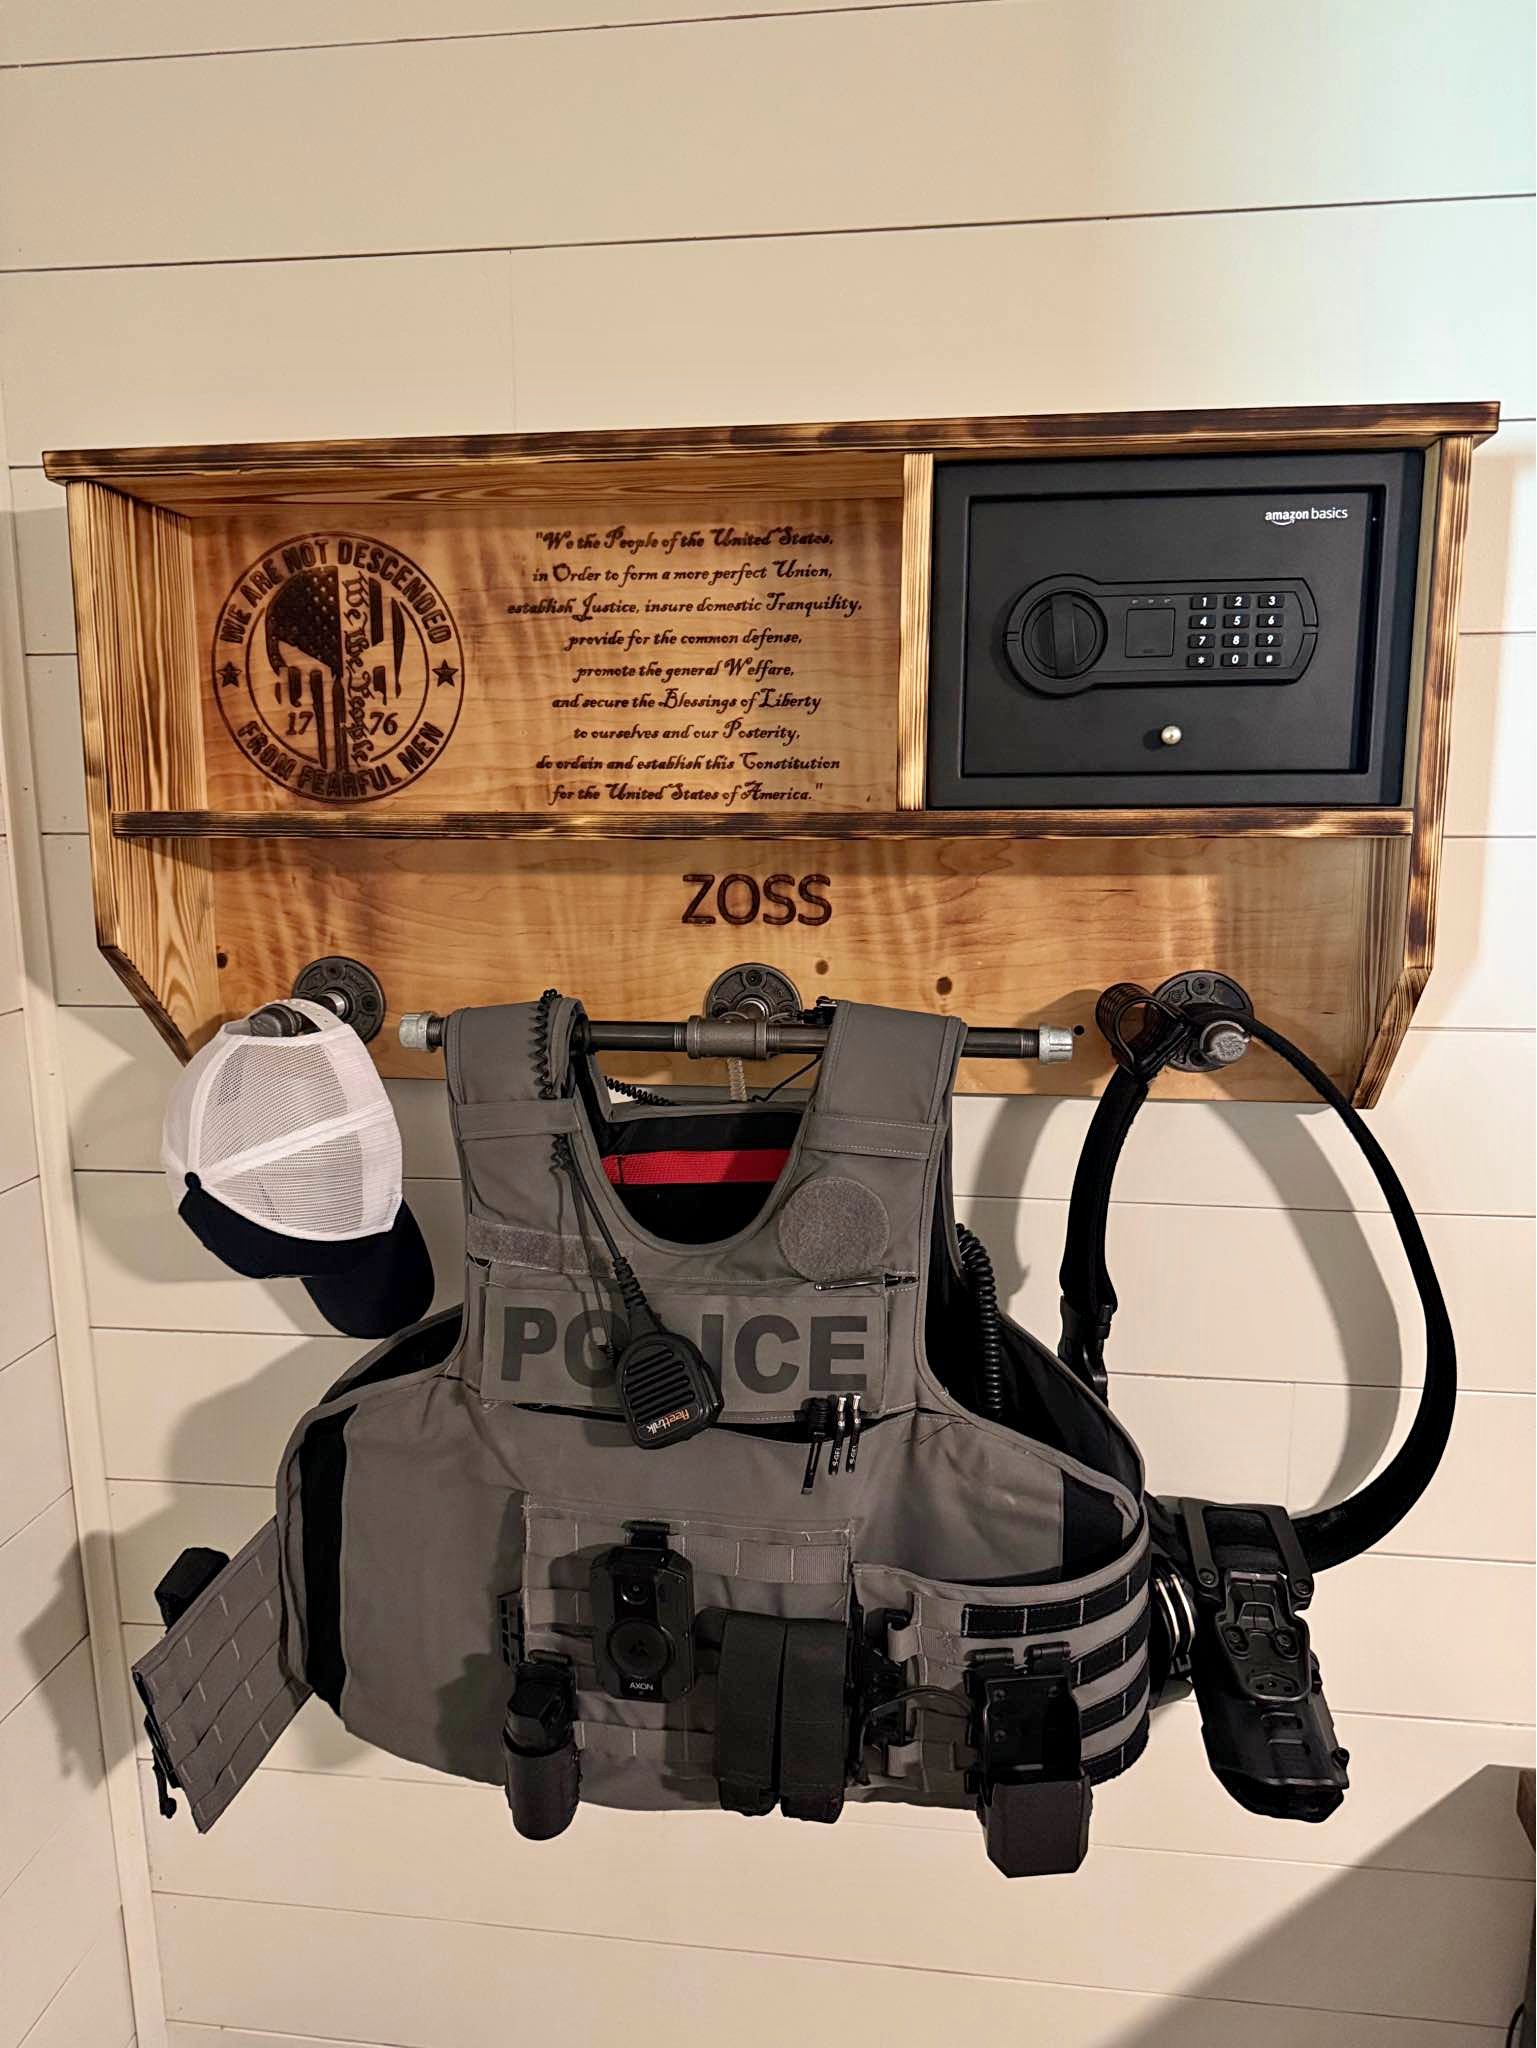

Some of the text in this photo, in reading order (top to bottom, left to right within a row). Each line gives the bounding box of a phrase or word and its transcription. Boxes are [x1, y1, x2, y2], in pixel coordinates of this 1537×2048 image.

[1265, 506, 1348, 526] amazon basics
[578, 532, 600, 548] the
[604, 526, 659, 554] People
[662, 532, 680, 554] of
[681, 530, 704, 548] the
[710, 528, 771, 547] United
[532, 560, 832, 587] in Order to form a more perfect Union,
[220, 539, 453, 645] WE ARE NOT DESCENDED
[1202, 597, 1208, 607] 1
[1234, 596, 1242, 606] 2
[1268, 596, 1276, 606] 3
[507, 598, 573, 615] establish
[572, 593, 640, 622] Justice,
[645, 600, 693, 613] insure
[697, 594, 761, 612] domestic
[1200, 616, 1207, 626] 4
[1233, 616, 1241, 625] 5
[1268, 616, 1275, 625] 6
[564, 628, 802, 651] provide for the common defense,
[1199, 636, 1206, 646] 7
[1232, 635, 1240, 645] 8
[1267, 635, 1274, 644] 9
[572, 658, 794, 683] promote the general Welfare,
[1232, 654, 1239, 664] 0
[552, 688, 821, 714] and secure the Blessings of Liberty
[286, 712, 314, 735] 17
[369, 712, 398, 736] 76
[574, 717, 800, 746] to ourselves and our Posterity,
[237, 720, 444, 797] FROM FEARFUL MEN
[536, 752, 840, 770] do ordain and establish this Constitution
[549, 785, 575, 806] for
[578, 784, 600, 800] the
[604, 783, 663, 800] United
[669, 783, 718, 801] States
[722, 786, 742, 806] of
[681, 873, 833, 926] ZOSS
[500, 1305, 868, 1393] POICE
[629, 1681, 654, 1691] AXON
